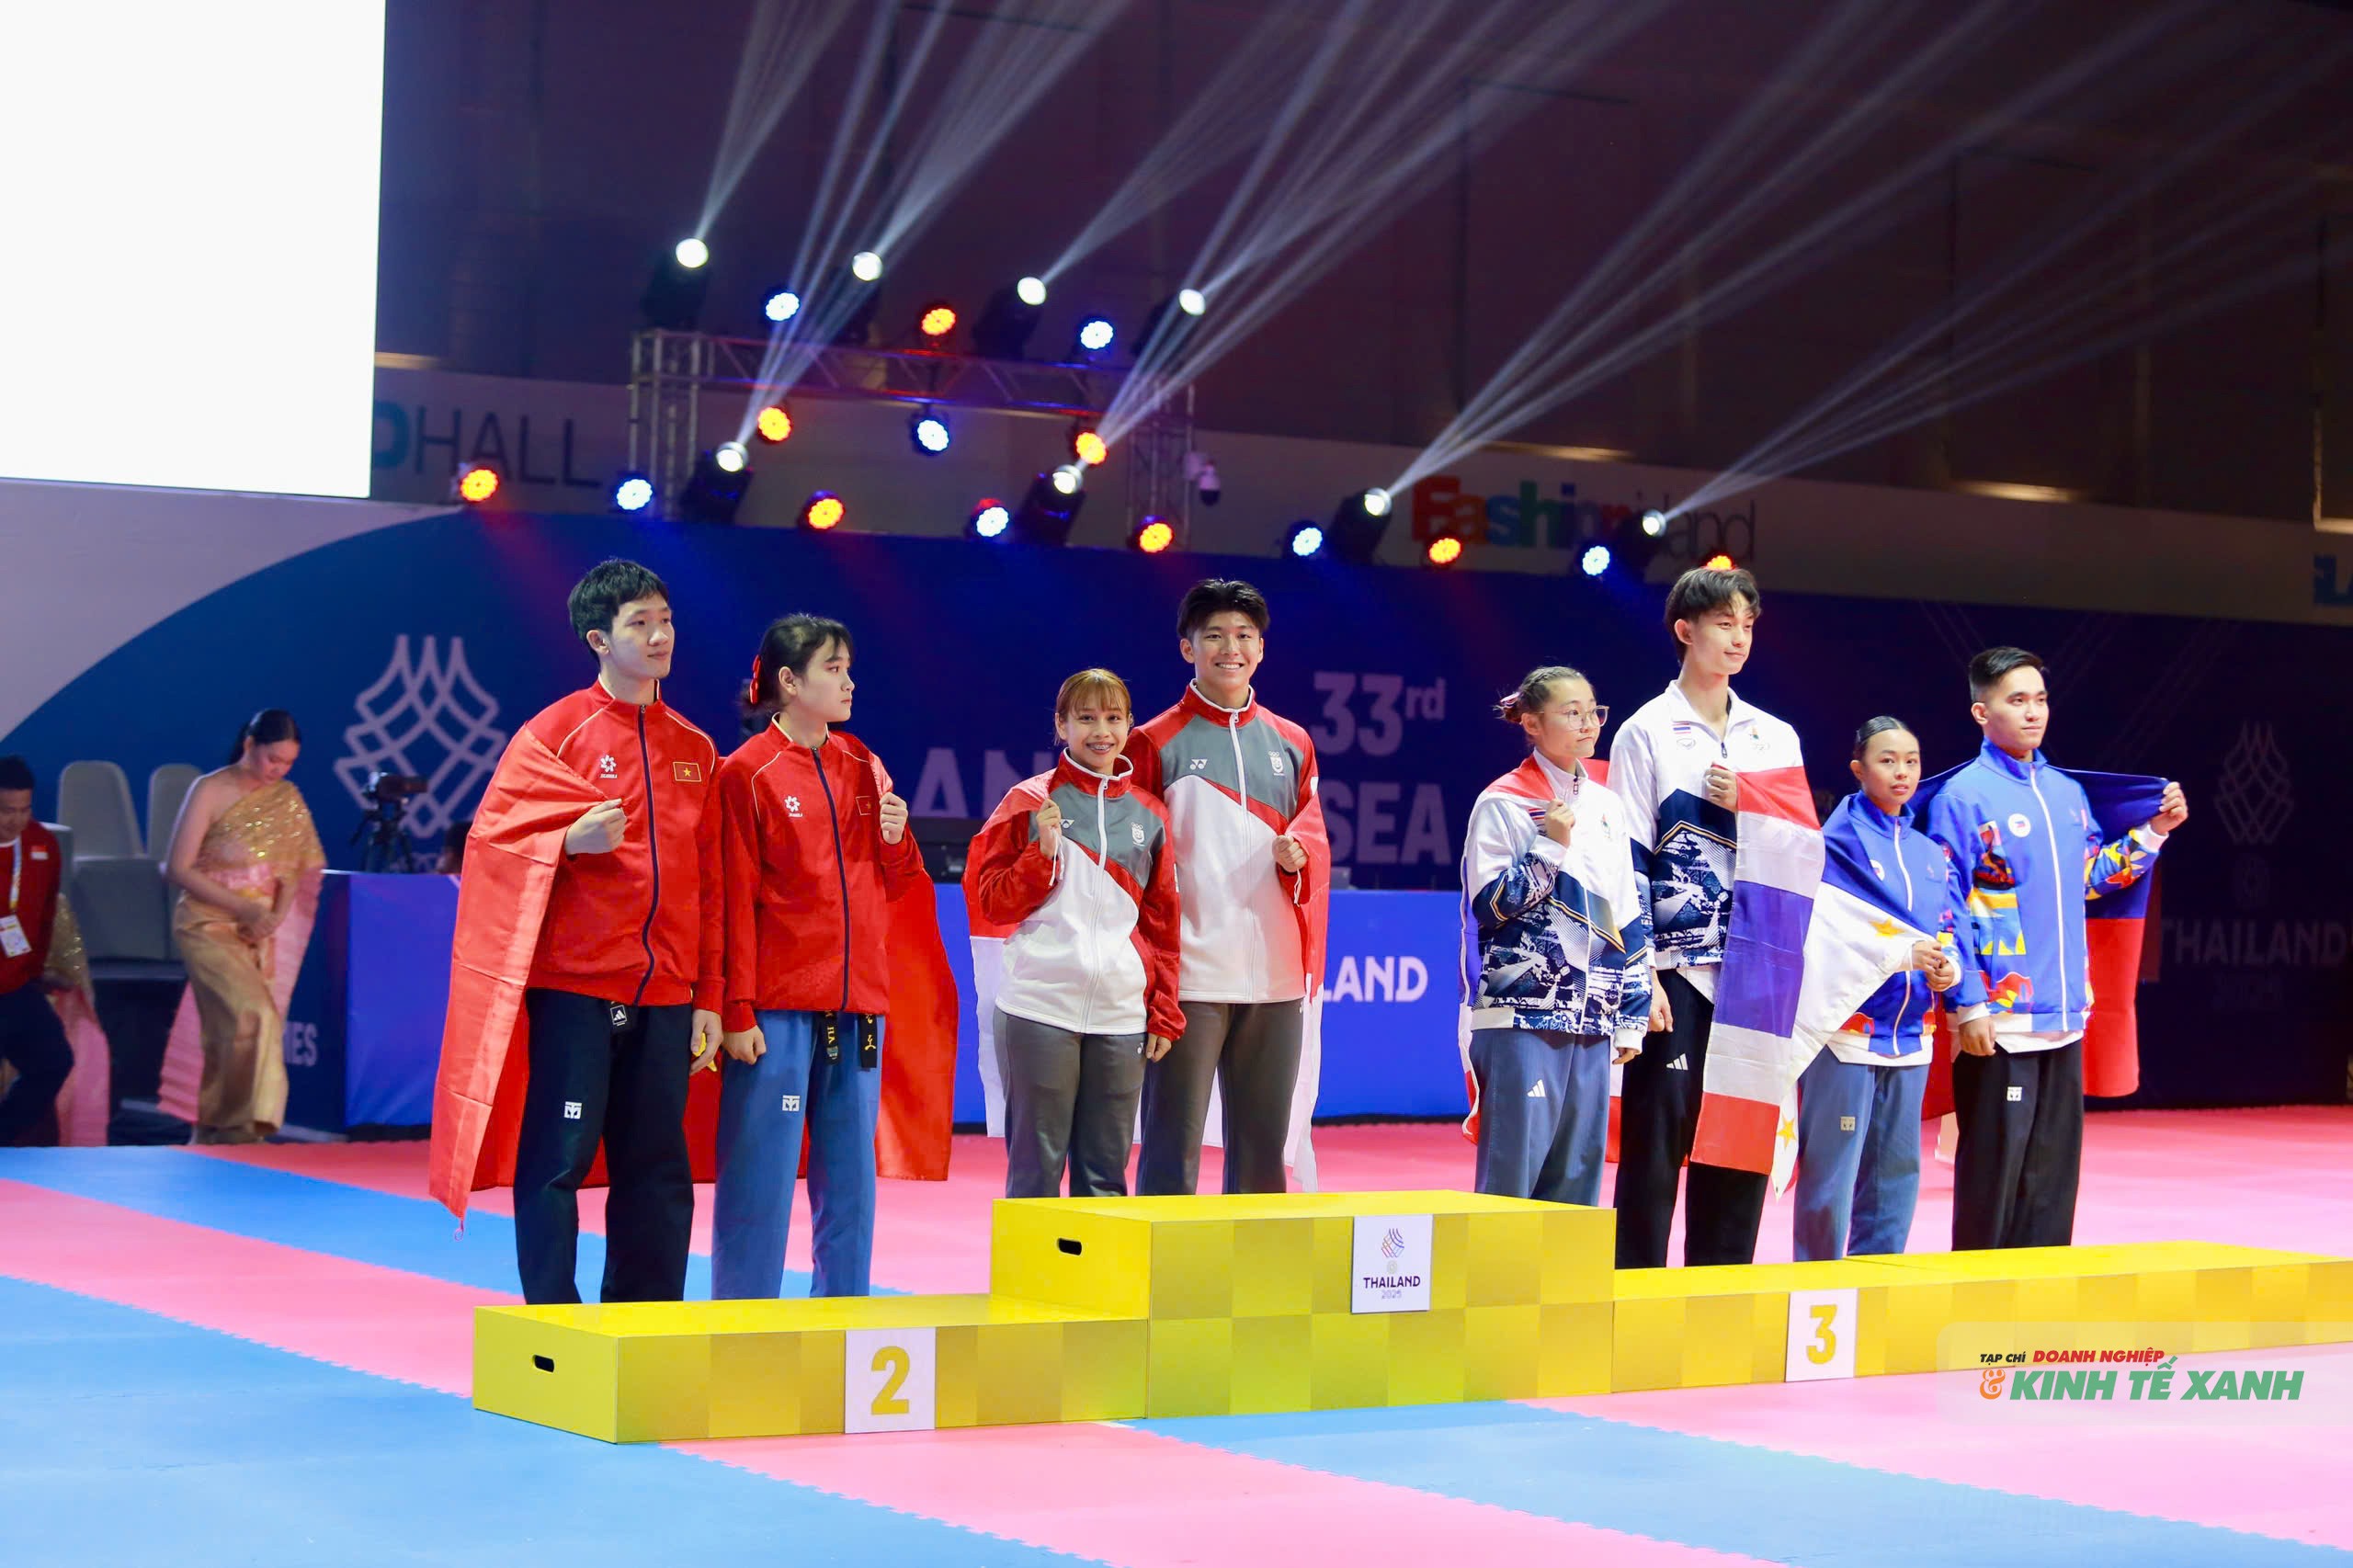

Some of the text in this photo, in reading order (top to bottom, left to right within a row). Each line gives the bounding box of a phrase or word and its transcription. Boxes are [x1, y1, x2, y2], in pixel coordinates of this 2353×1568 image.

[1309, 671, 1446, 756] 33rd
[1319, 779, 1452, 866] SEA
[1323, 956, 1428, 1002] AND
[1363, 1276, 1421, 1289] THAILAND
[1806, 1304, 1837, 1365] 3
[870, 1346, 910, 1415] 2
